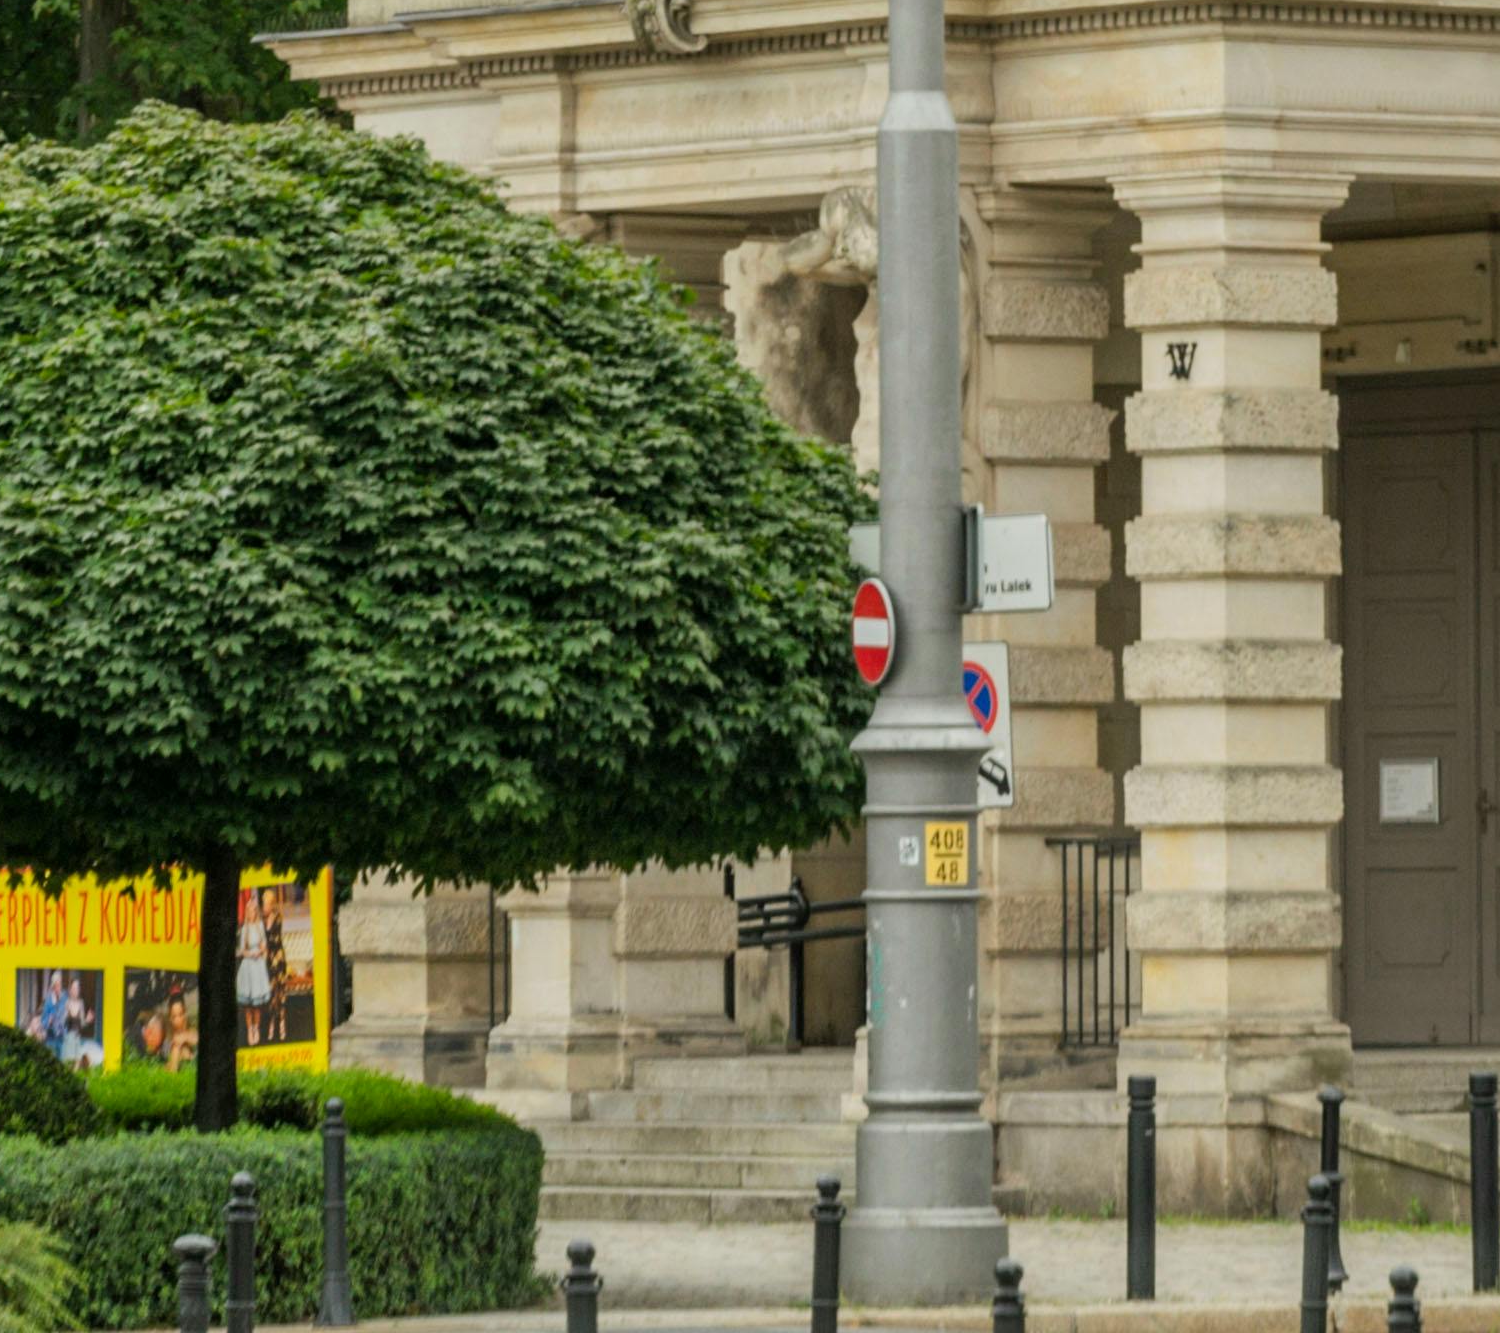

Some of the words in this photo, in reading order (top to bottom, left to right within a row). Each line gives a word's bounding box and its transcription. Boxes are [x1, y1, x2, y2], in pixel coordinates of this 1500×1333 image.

[1001, 578, 1033, 594] Lalek
[929, 827, 964, 851] 408
[935, 860, 959, 884] 48
[77, 891, 89, 944] Z
